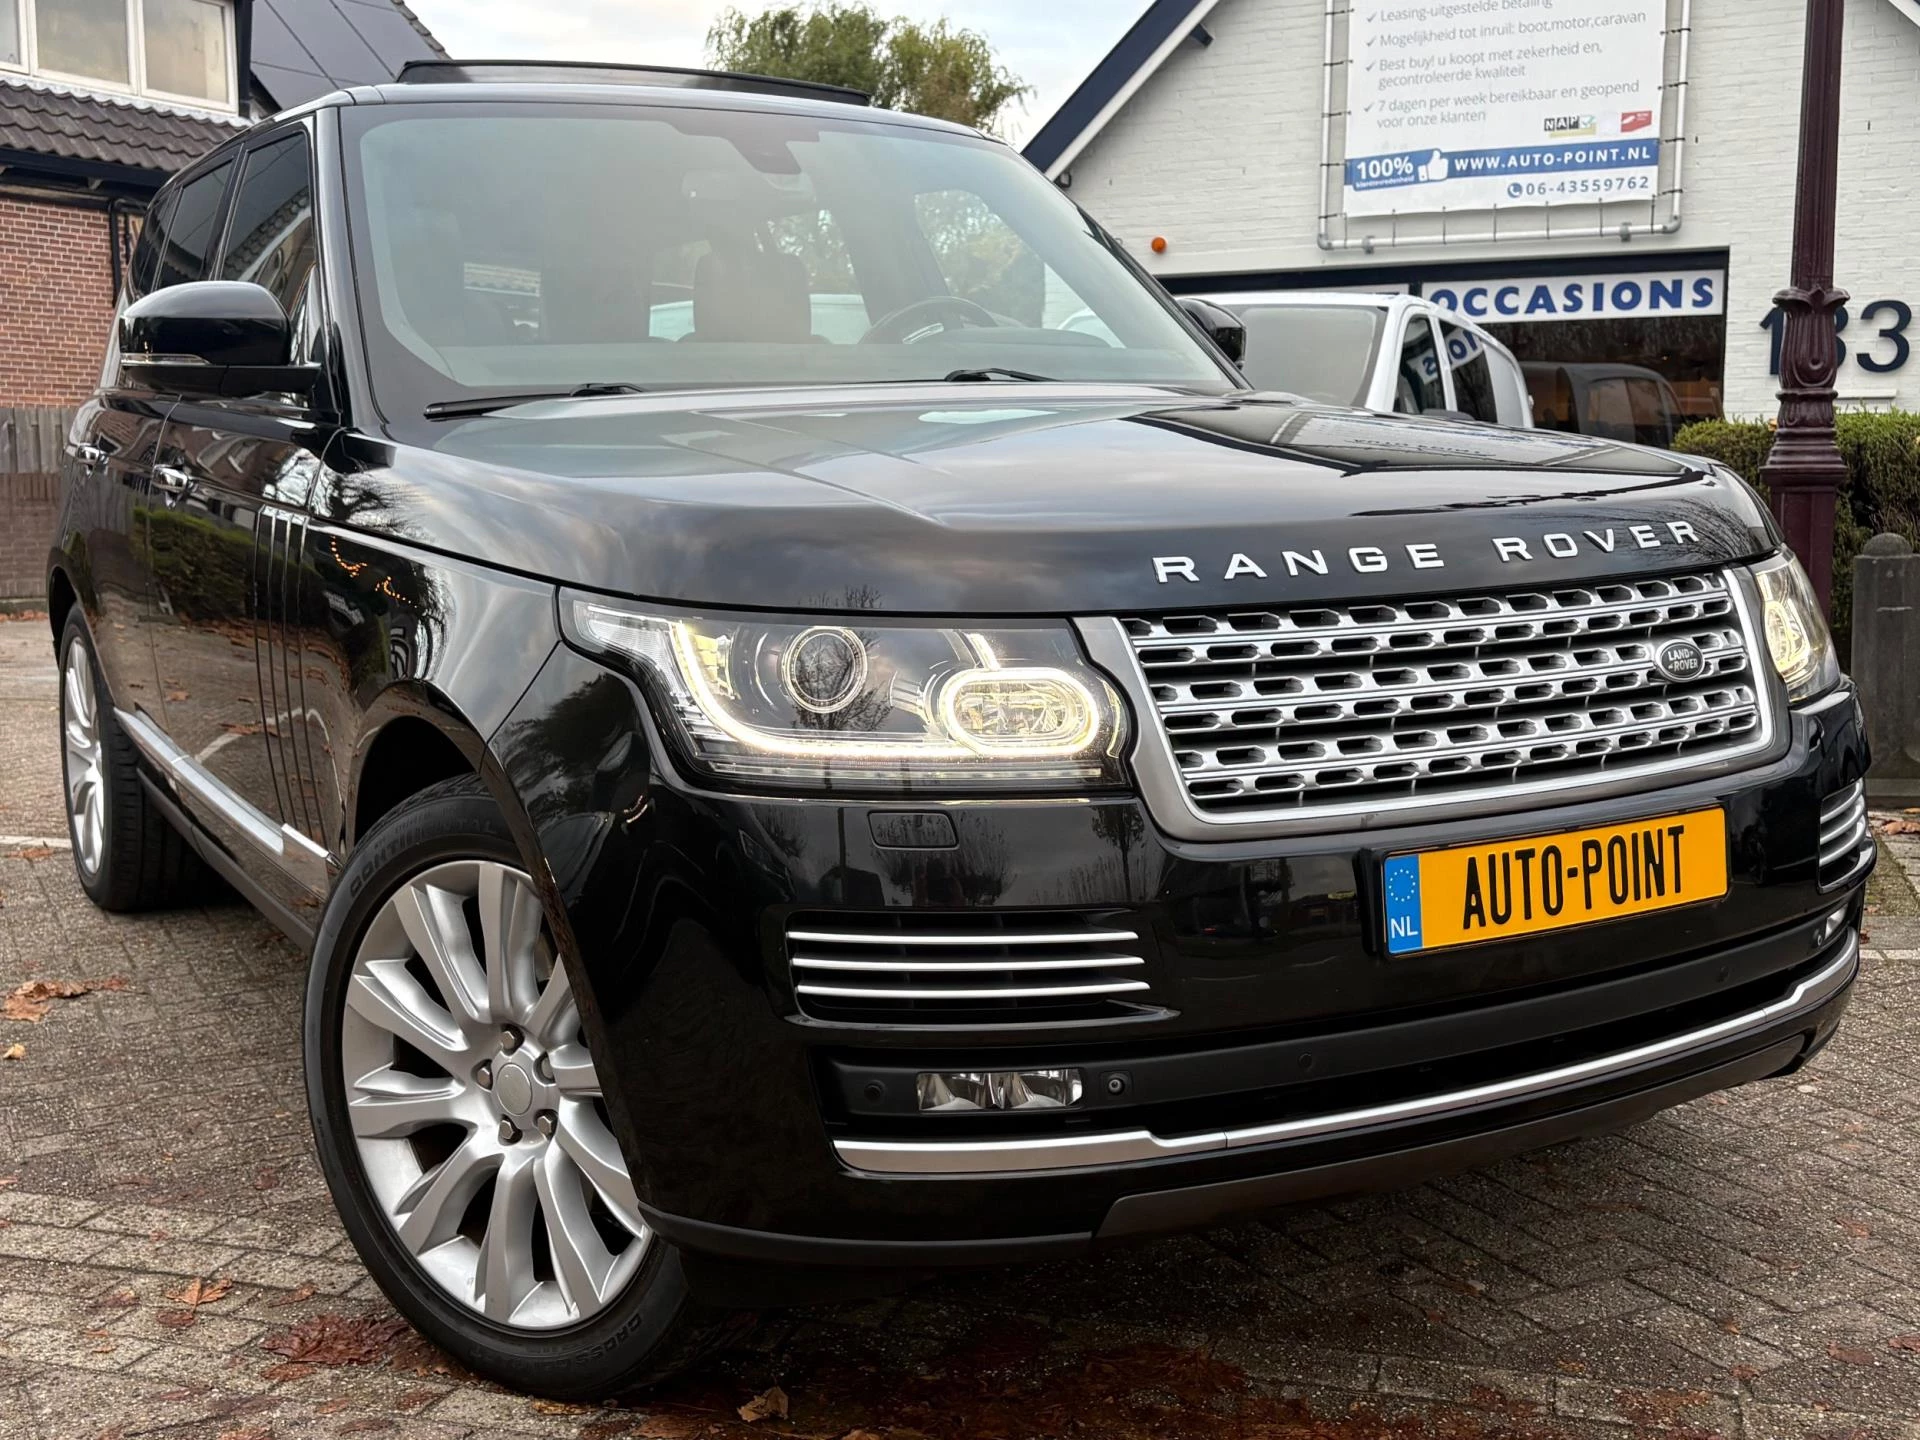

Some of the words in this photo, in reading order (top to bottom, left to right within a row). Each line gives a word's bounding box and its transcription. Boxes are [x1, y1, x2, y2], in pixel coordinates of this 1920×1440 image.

[1380, 28, 1456, 48] Mogelijkheid
[1460, 27, 1477, 39] tot
[1379, 58, 1405, 71] Best
[1438, 57, 1446, 66] u
[1449, 52, 1484, 66] koopt
[1488, 49, 1513, 61] met
[1516, 41, 1580, 60] zekerheid
[1378, 69, 1472, 91] gecontroleerde
[1475, 64, 1526, 79] kwaliteit
[1379, 100, 1387, 112] 7
[1389, 98, 1427, 114] dagen
[1430, 98, 1450, 110] per
[1454, 92, 1488, 106] week
[1489, 86, 1557, 104] bereikbaar
[1561, 87, 1578, 98] en
[1580, 80, 1640, 99] geopend
[1377, 117, 1404, 129] voor
[1407, 114, 1437, 127] onze
[1440, 110, 1486, 124] klanten
[1357, 156, 1414, 180] 100%
[1454, 146, 1651, 171] WWW.AUTO-POINT.NL
[1526, 176, 1649, 195] 06-43559762
[1429, 278, 1714, 316] OCCASIONS
[1152, 543, 1445, 583] RANGE
[1492, 520, 1700, 562] ROVER
[1668, 648, 1690, 662] LAND
[1674, 658, 1699, 672] ROVER
[1463, 824, 1685, 930] AUTO-POINT
[1390, 915, 1418, 939] NL
